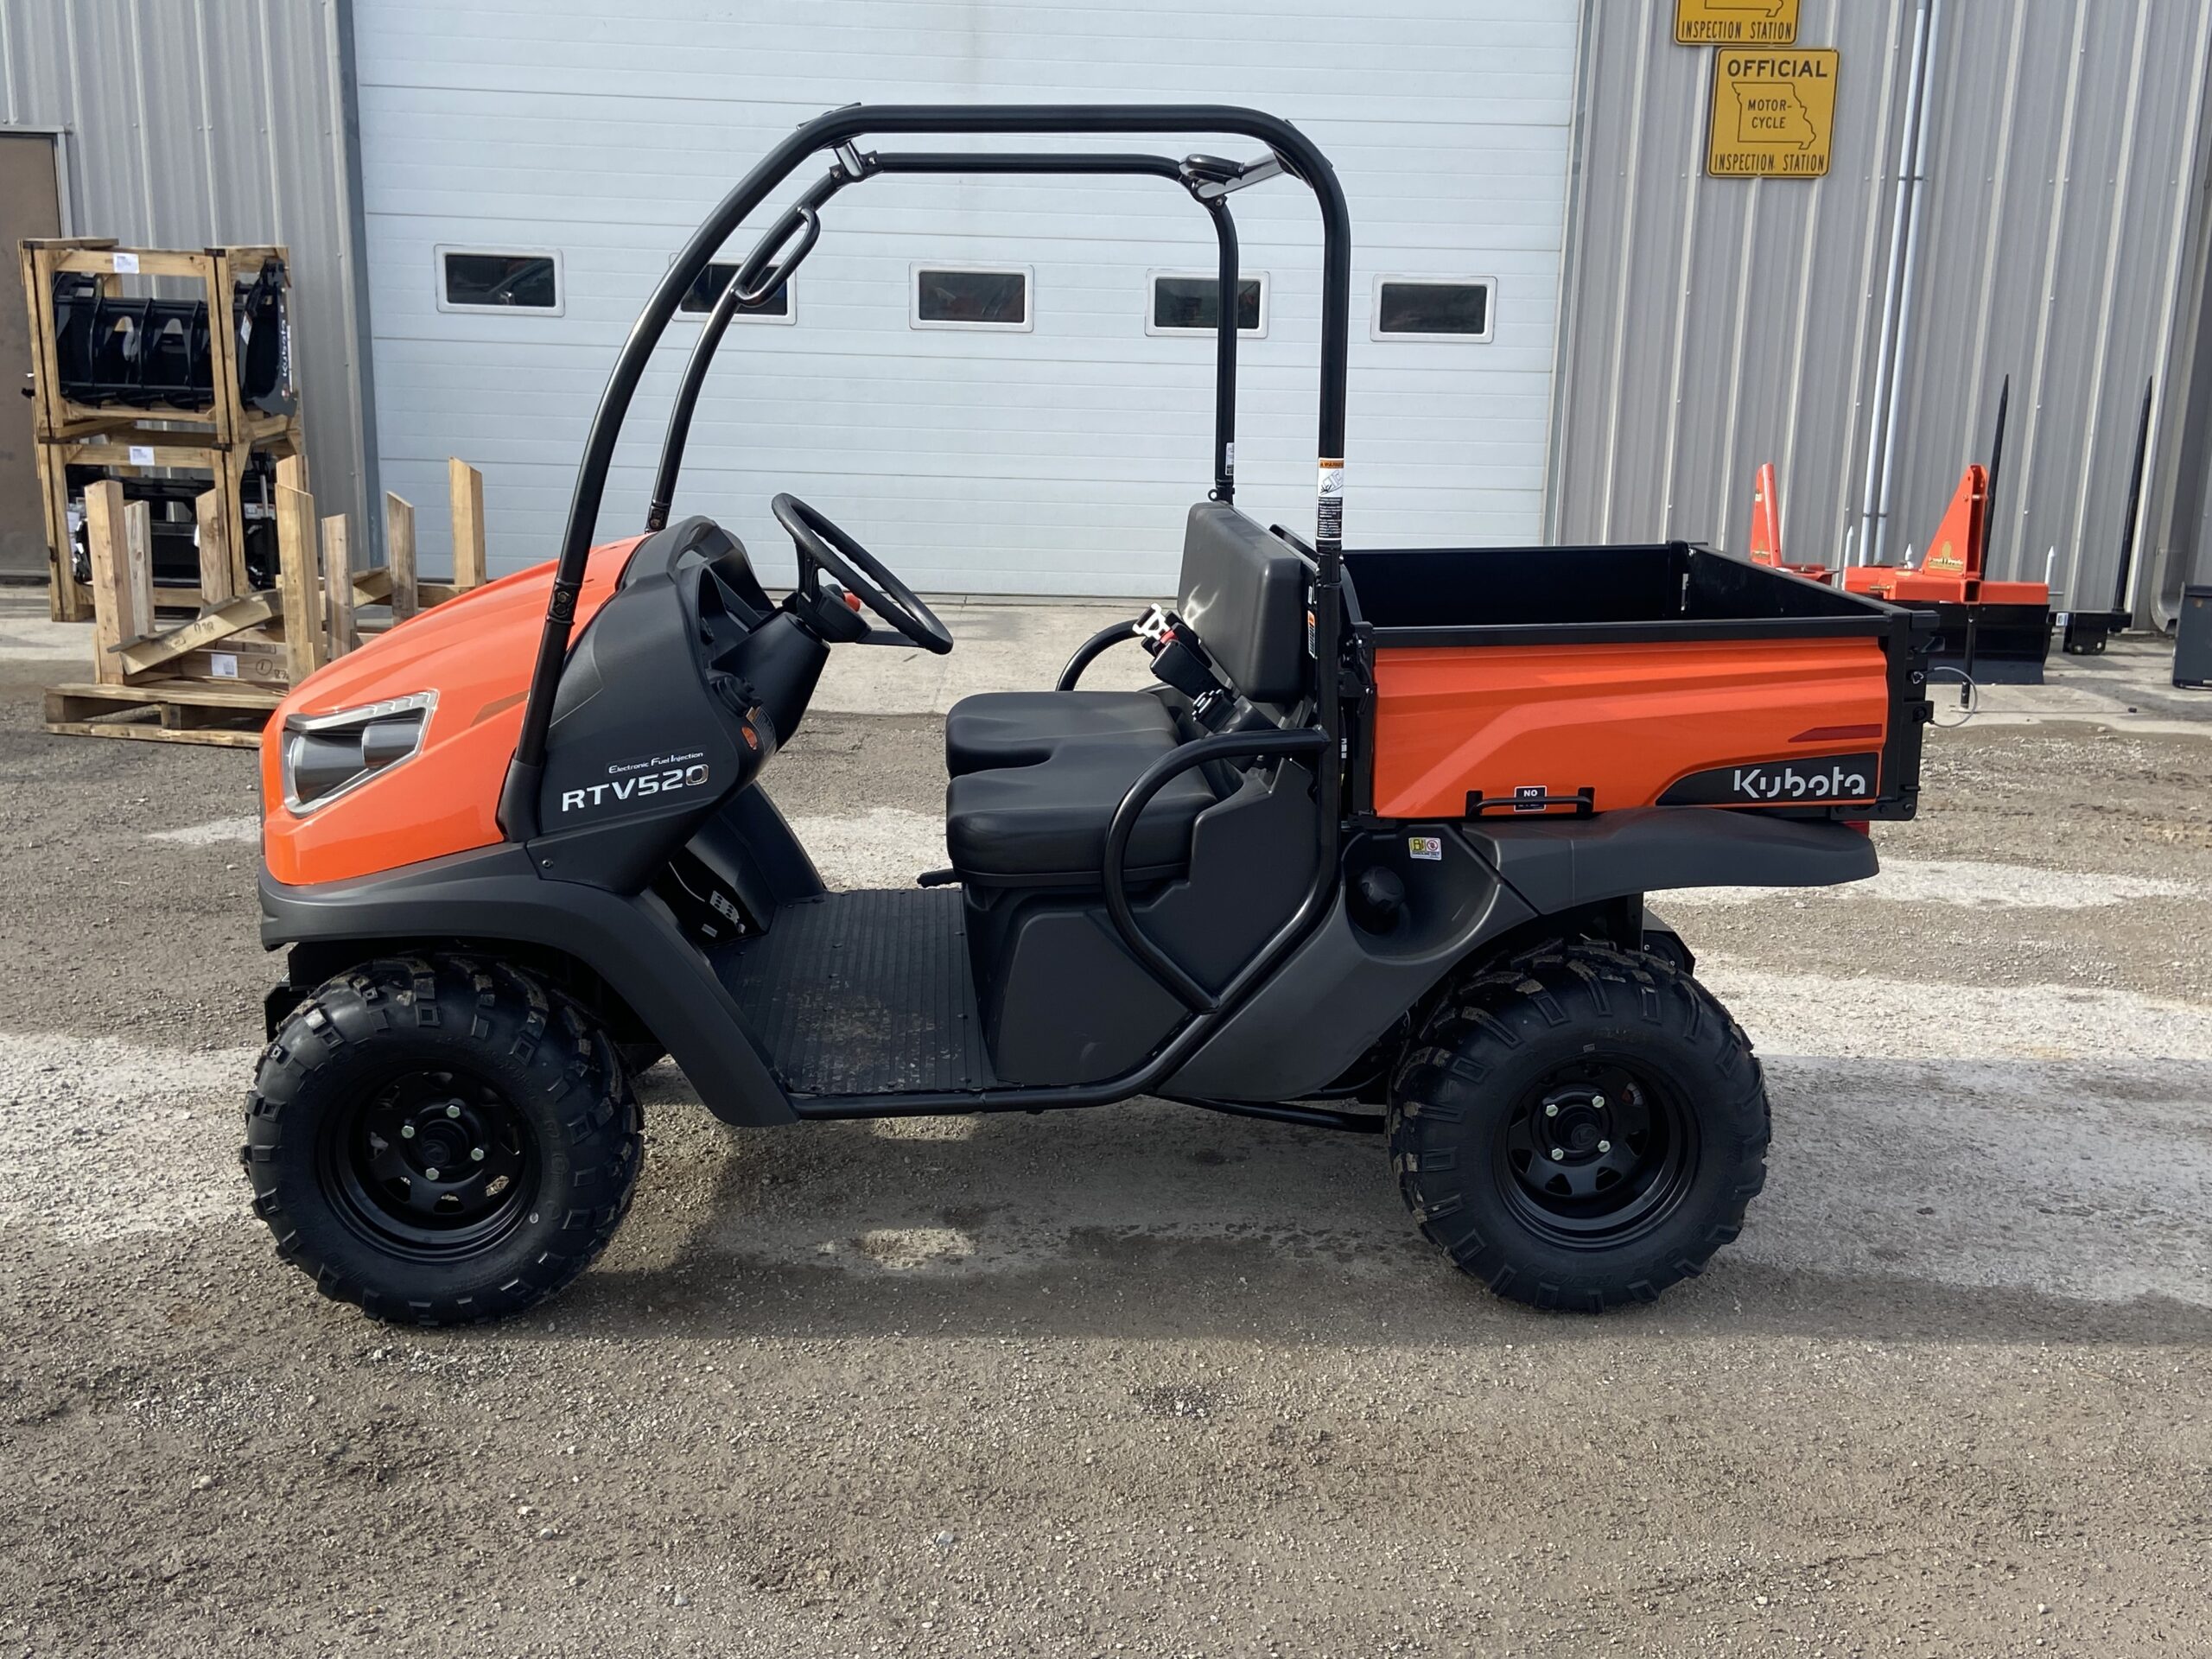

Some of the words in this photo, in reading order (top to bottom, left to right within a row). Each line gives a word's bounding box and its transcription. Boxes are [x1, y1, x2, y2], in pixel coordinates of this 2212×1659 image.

[1681, 21, 1742, 39] INSPECTION
[1750, 21, 1792, 40] STATION
[1727, 59, 1827, 78] OFFICIAL
[1748, 99, 1792, 111] MOTOR-
[1751, 117, 1786, 129] CYCLE
[1714, 154, 1775, 171] INSPECTION
[1783, 154, 1825, 171] STATION
[608, 761, 649, 774] Electronic
[651, 757, 670, 766] Fuel
[671, 751, 703, 763] Injection
[562, 763, 709, 812] RTV520
[1733, 766, 1866, 798] Kubota
[1523, 789, 1538, 798] NO
